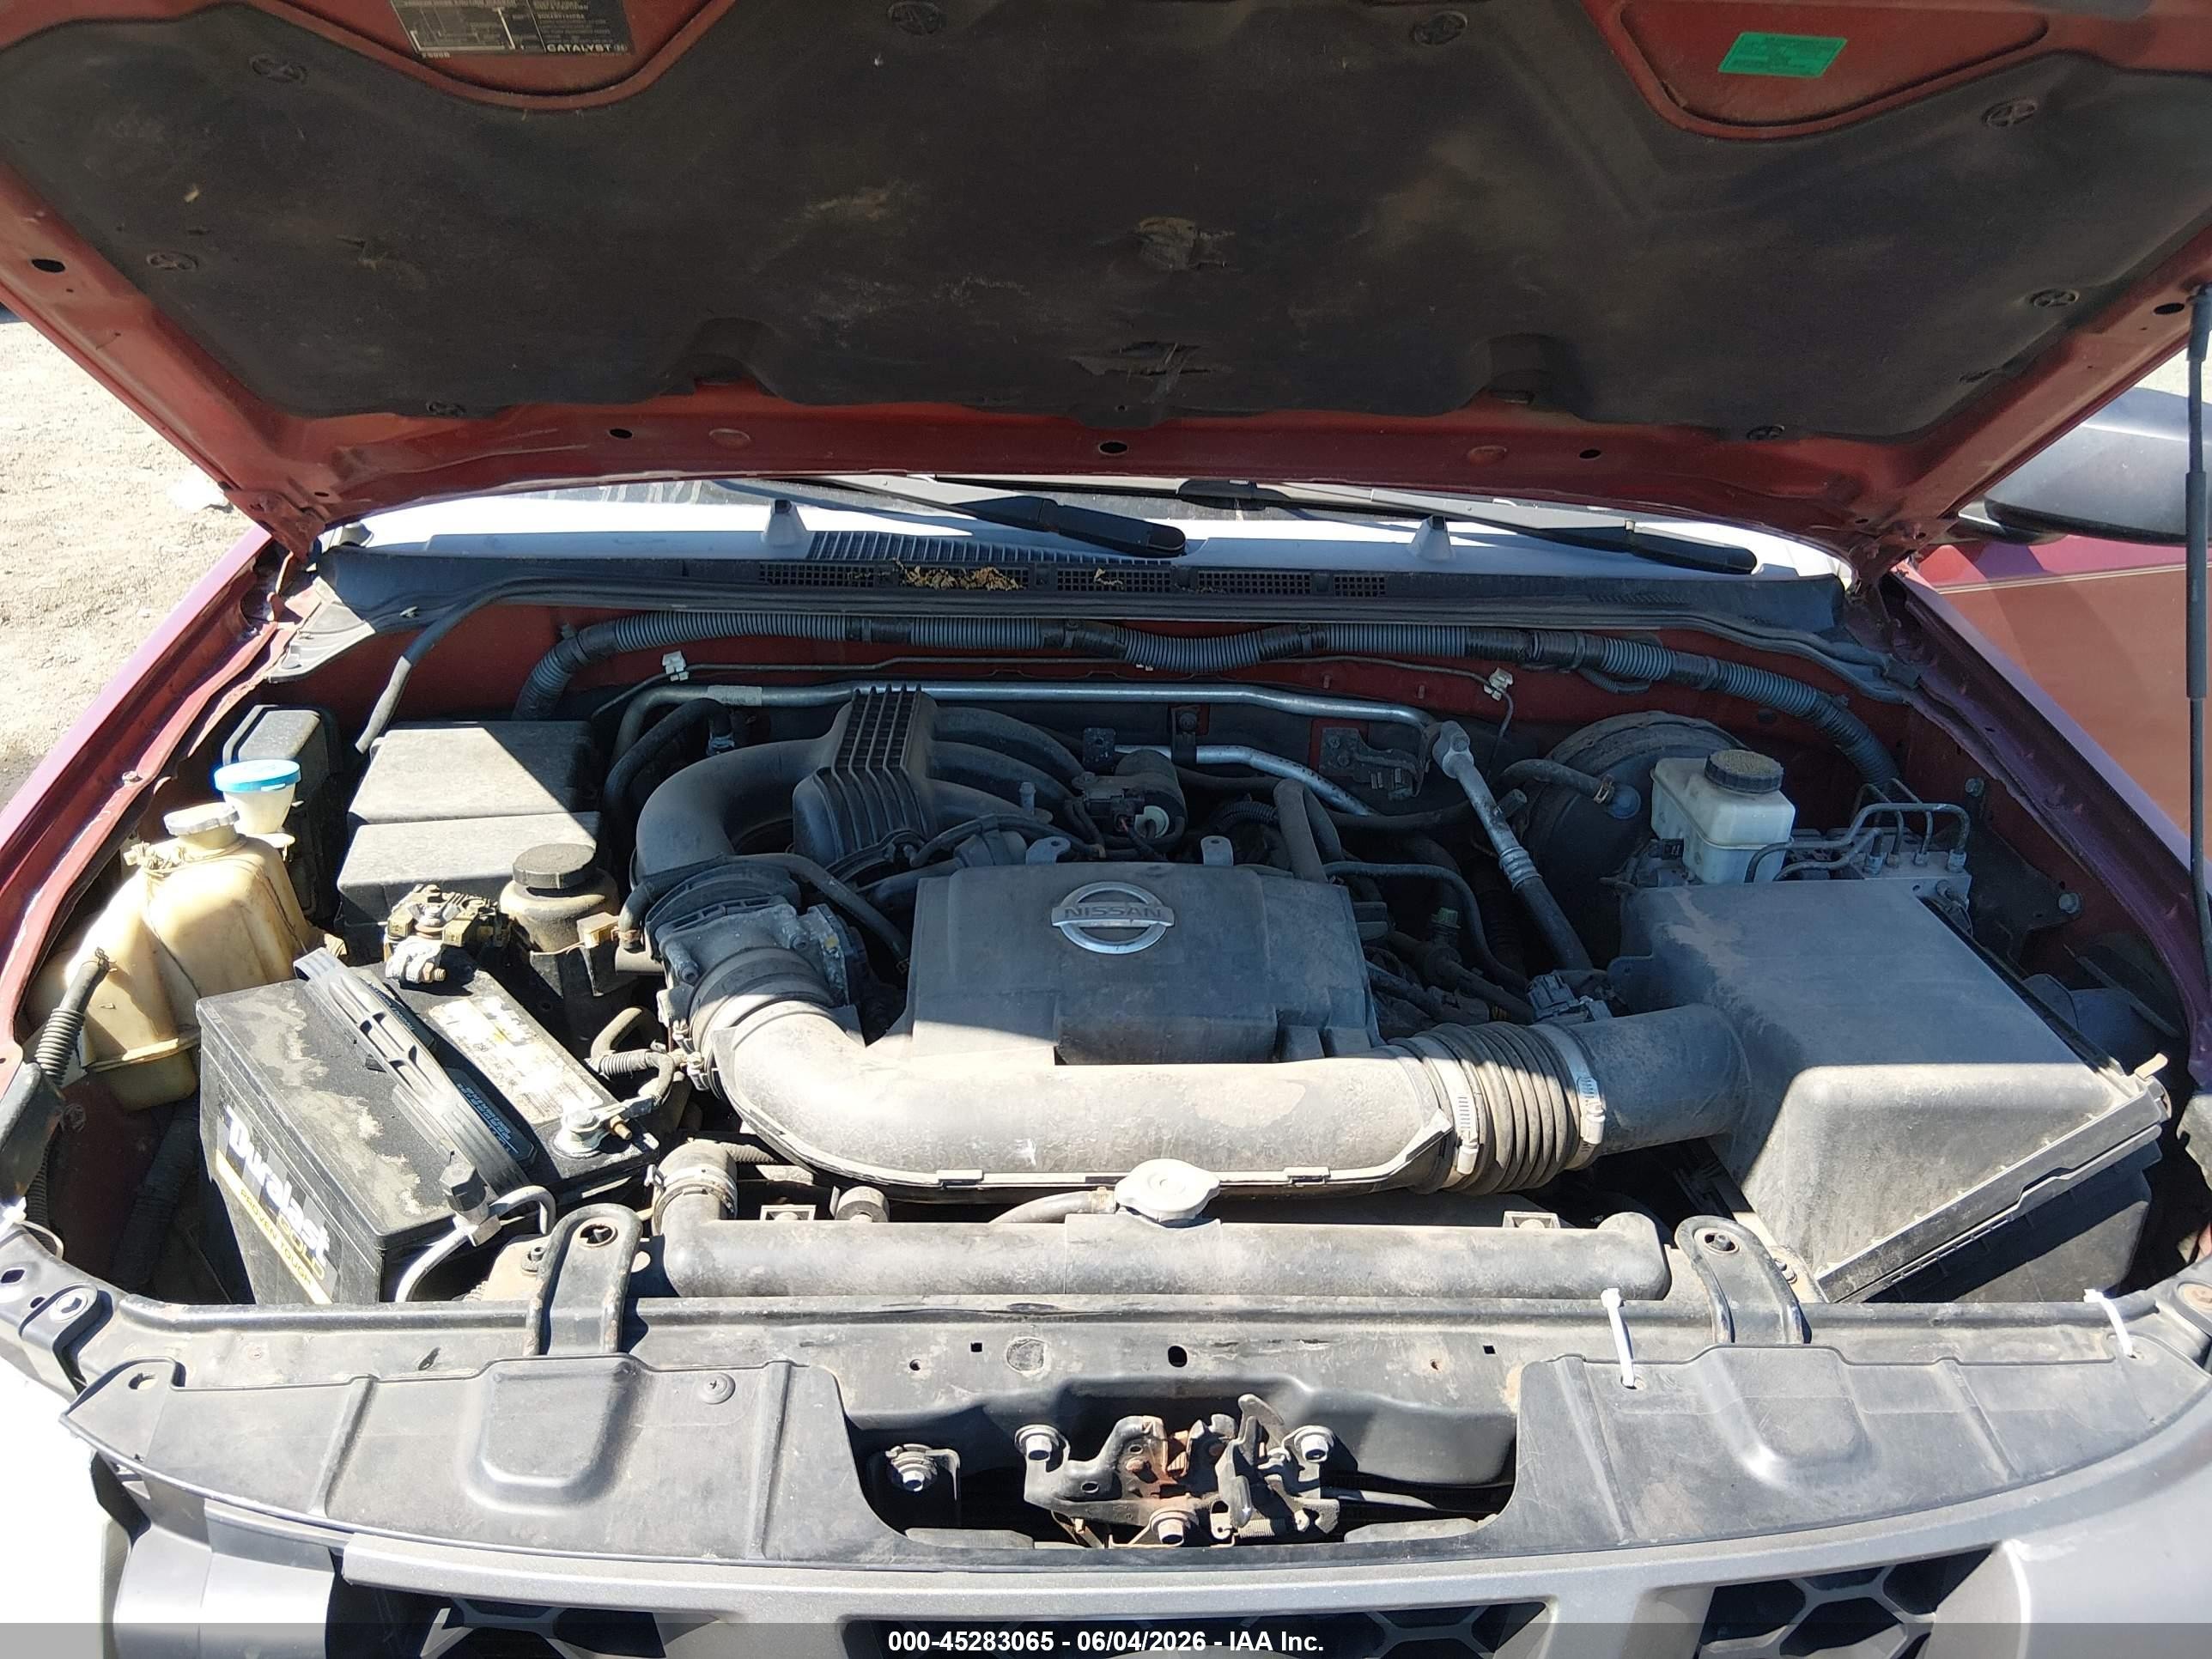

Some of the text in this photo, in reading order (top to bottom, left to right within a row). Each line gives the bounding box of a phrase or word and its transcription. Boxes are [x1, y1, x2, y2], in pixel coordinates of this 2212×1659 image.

[547, 44, 611, 52] CATALYST
[1064, 906, 1162, 919] NISSAN
[225, 1105, 331, 1267] Duralast
[240, 1188, 313, 1286] PROVEN TOUGH
